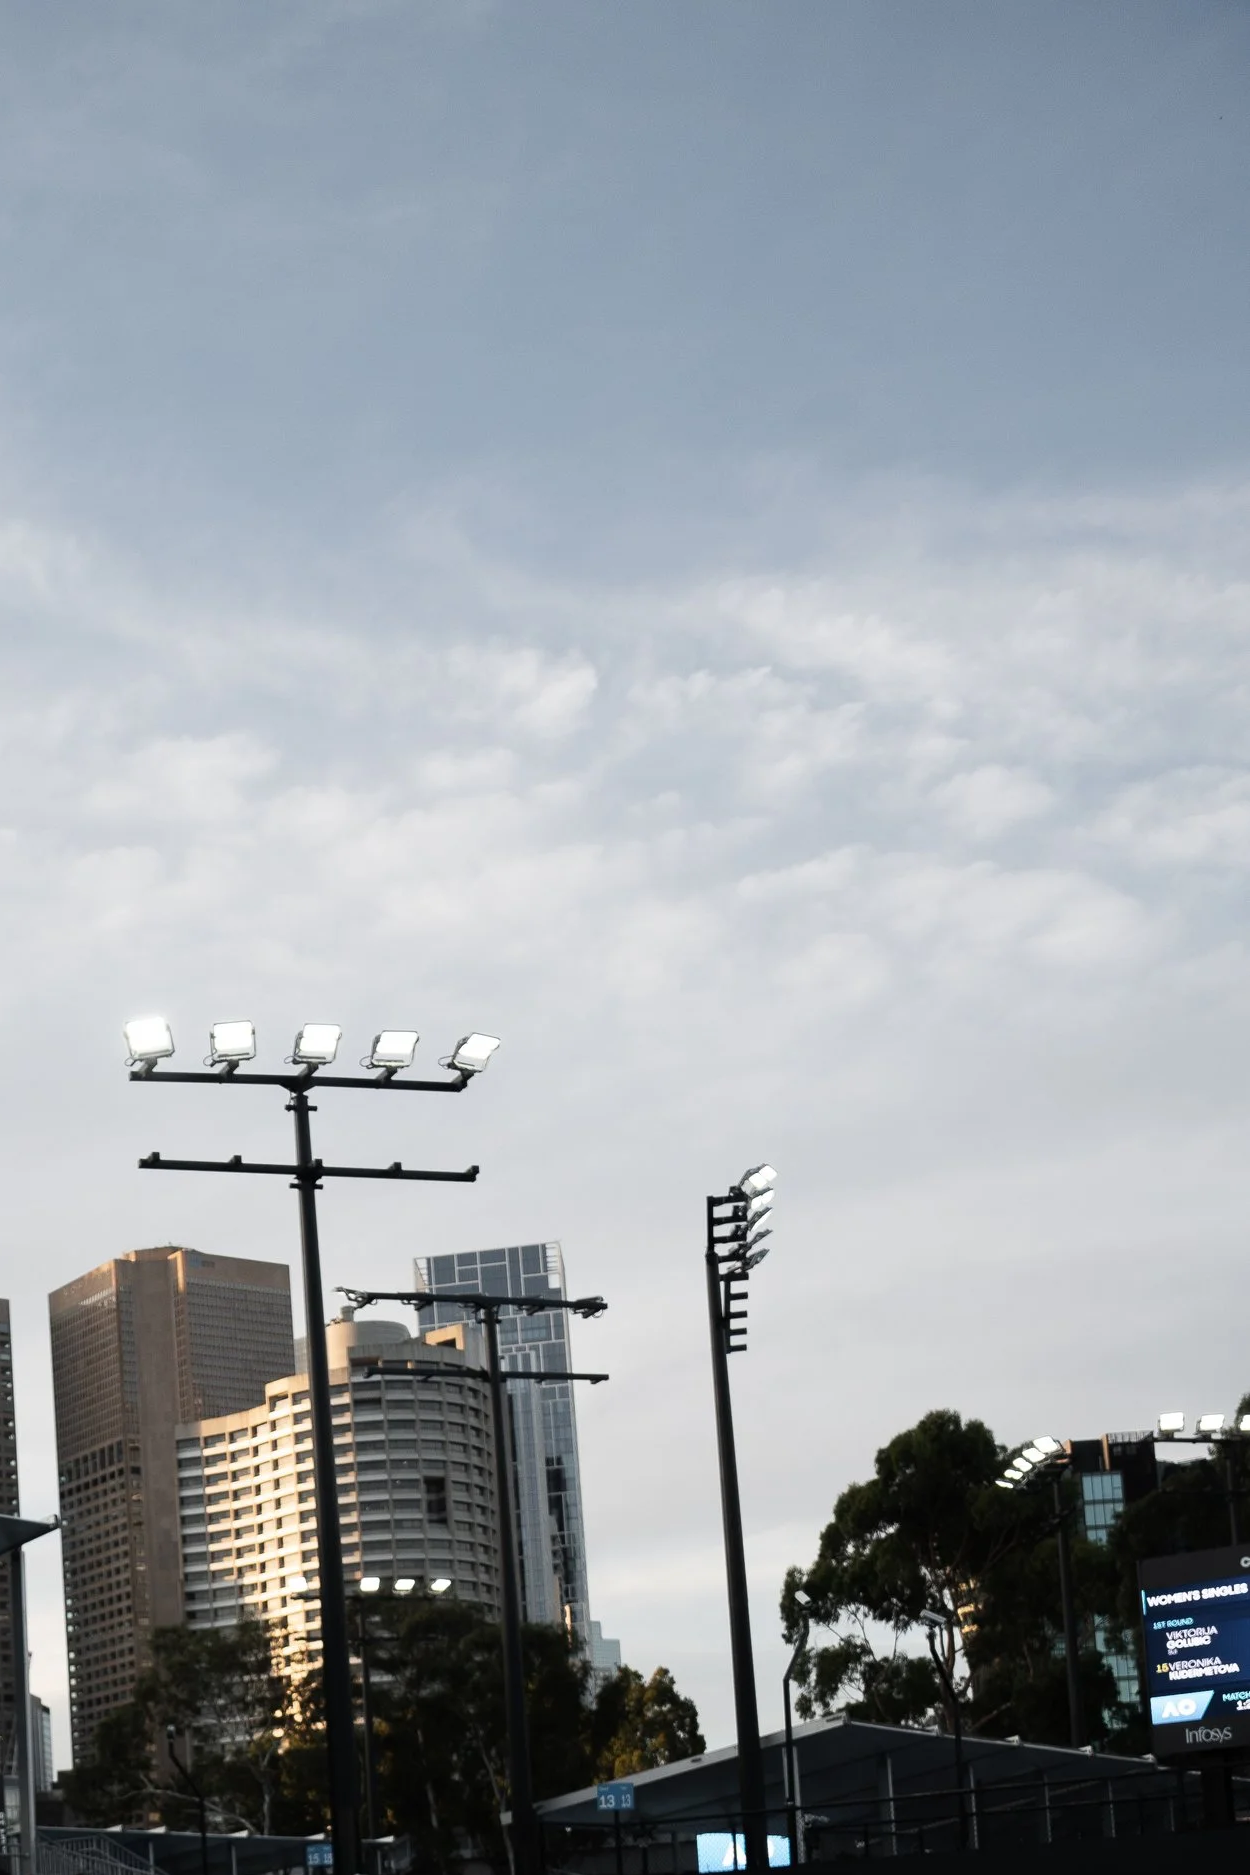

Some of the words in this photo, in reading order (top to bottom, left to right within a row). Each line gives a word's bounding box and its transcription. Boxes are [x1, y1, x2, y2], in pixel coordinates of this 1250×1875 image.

[1147, 1590, 1200, 1607] WOMEN'S
[1201, 1583, 1248, 1599] SINGLES
[1166, 1618, 1194, 1628] ROUND
[1169, 1656, 1222, 1671] VERONIKA
[1169, 1663, 1240, 1680] KUDERMETOVA
[1161, 1698, 1197, 1718] AO
[1185, 1726, 1232, 1744] Infosys
[599, 1794, 615, 1809] 13
[621, 1793, 631, 1808] 13
